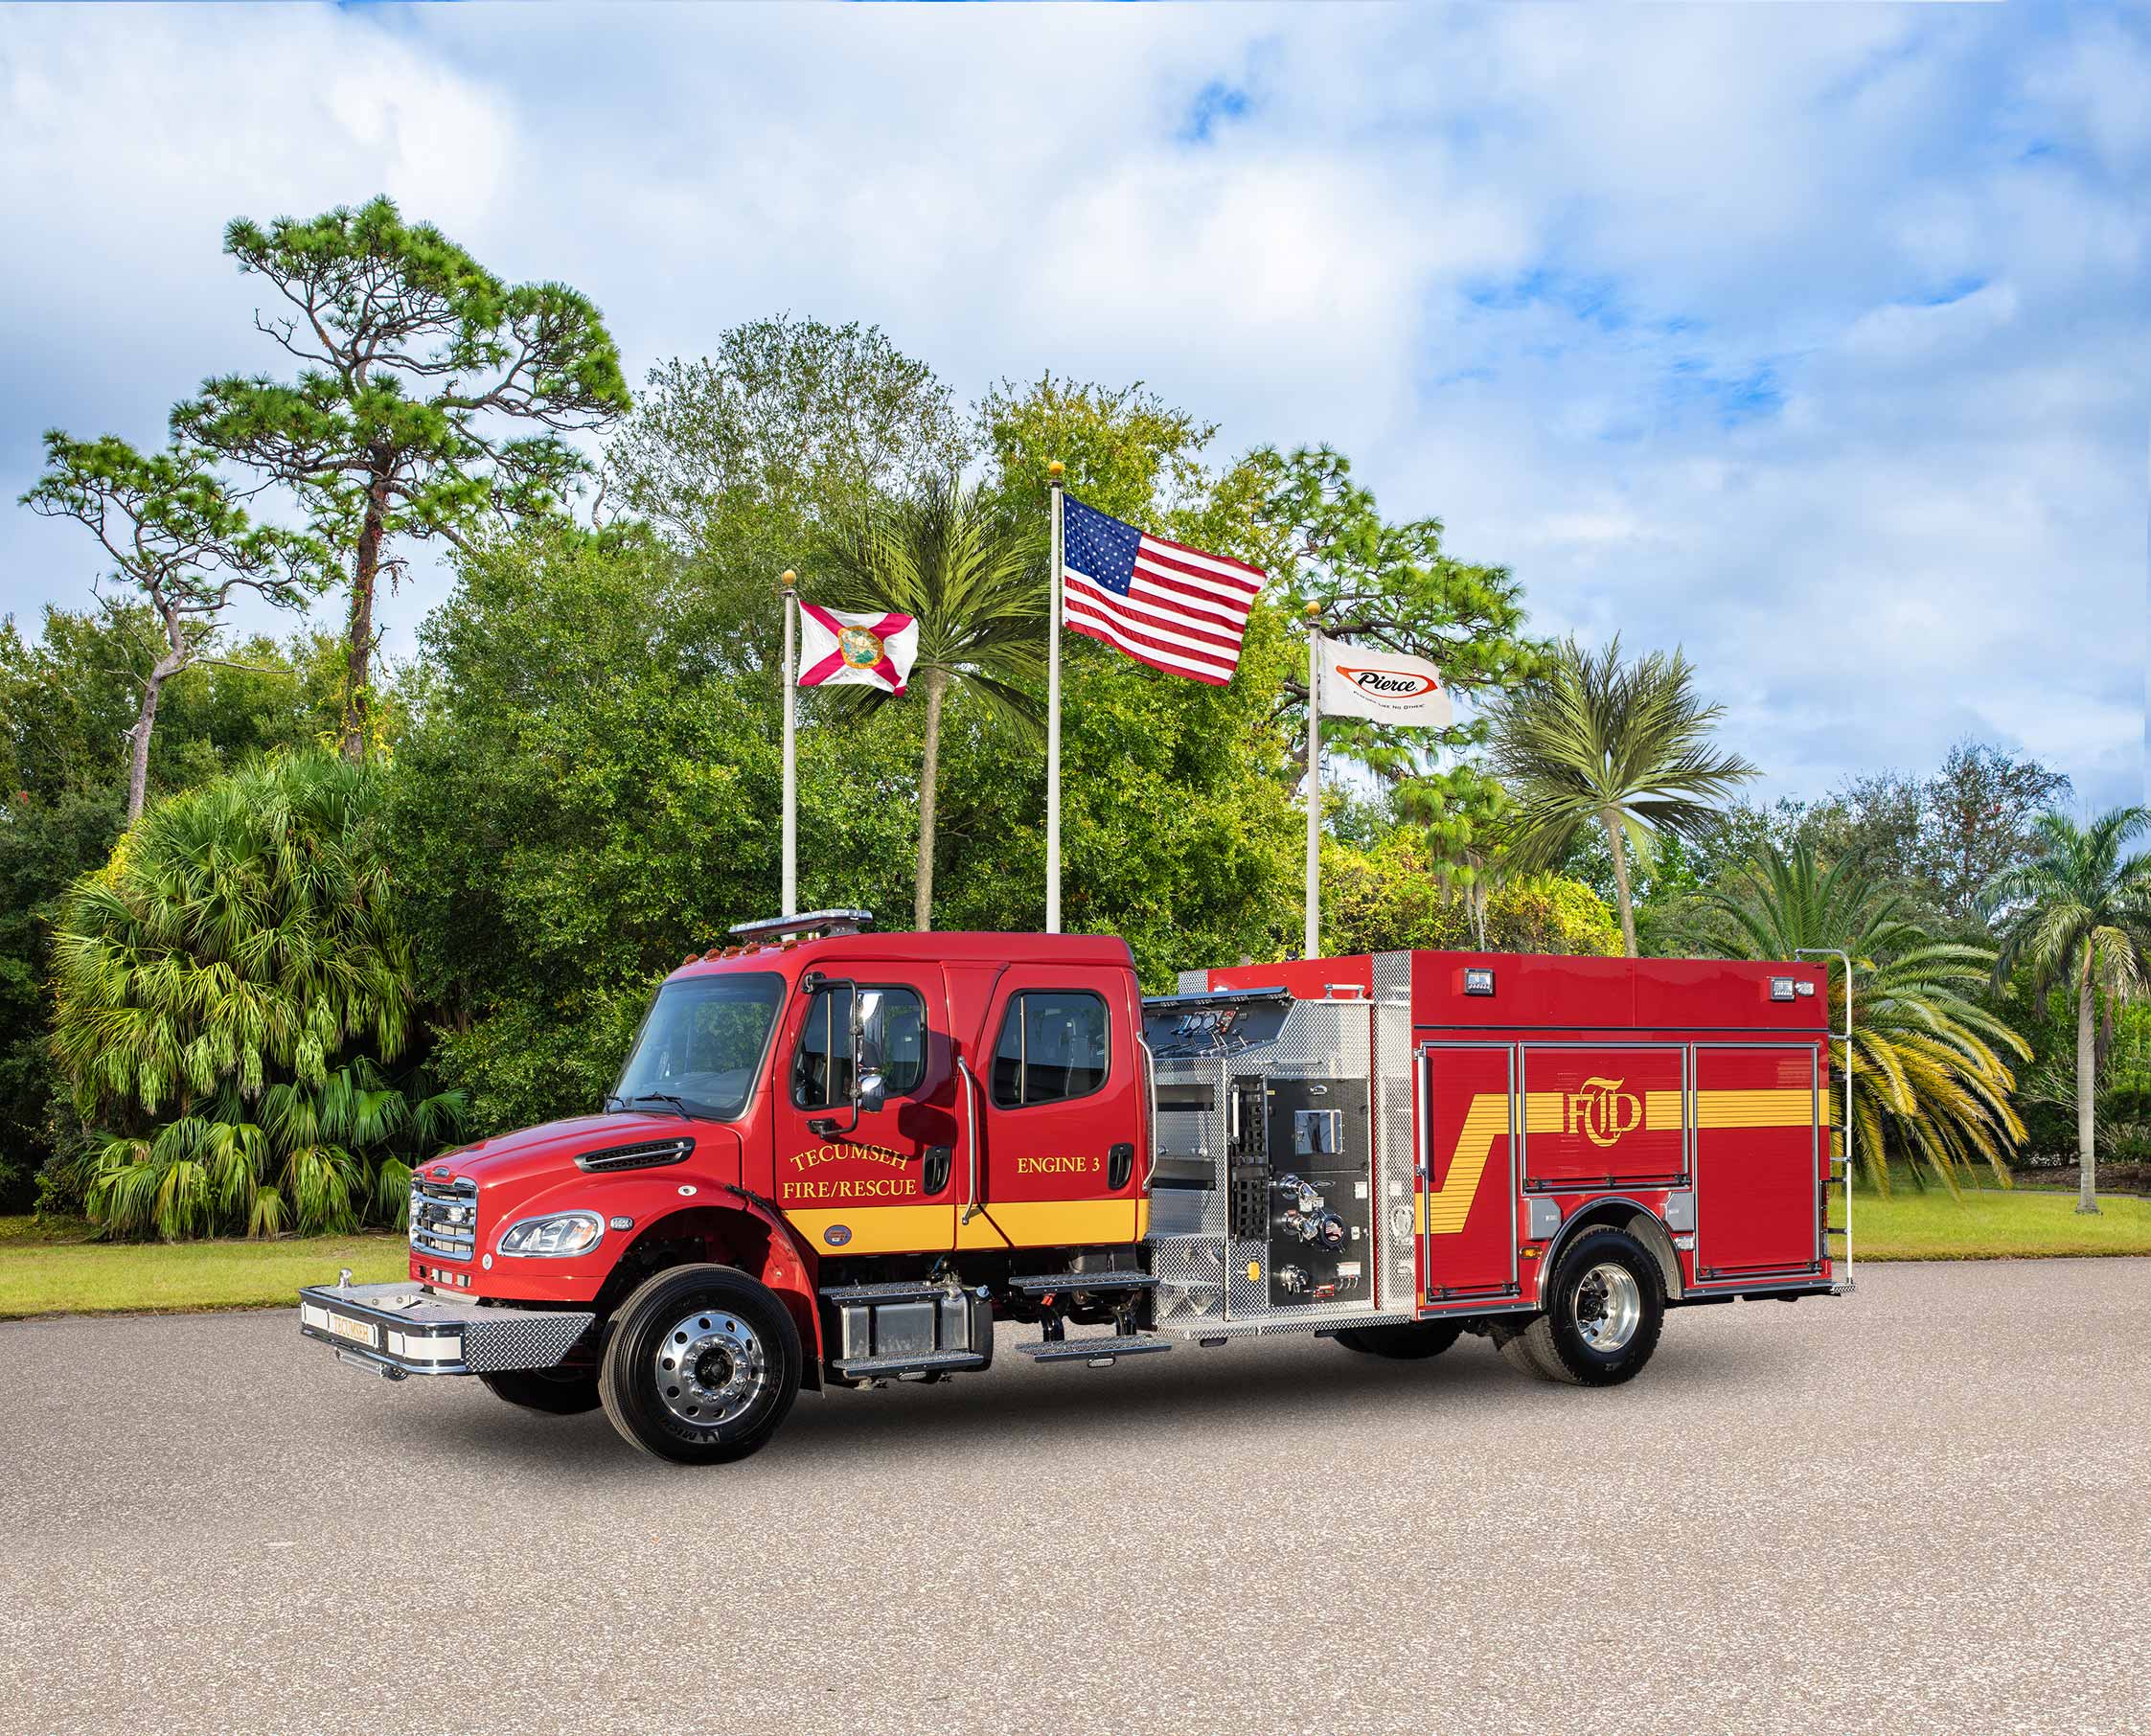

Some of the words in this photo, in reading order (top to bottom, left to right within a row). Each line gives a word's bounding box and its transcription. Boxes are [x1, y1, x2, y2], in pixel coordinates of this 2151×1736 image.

[1358, 672, 1417, 692] Pierce
[789, 1143, 910, 1172] TECUMSEH
[1017, 1156, 1087, 1174] ENGINE
[1091, 1156, 1101, 1172] 3
[782, 1179, 917, 1199] FIRE/RESCUE
